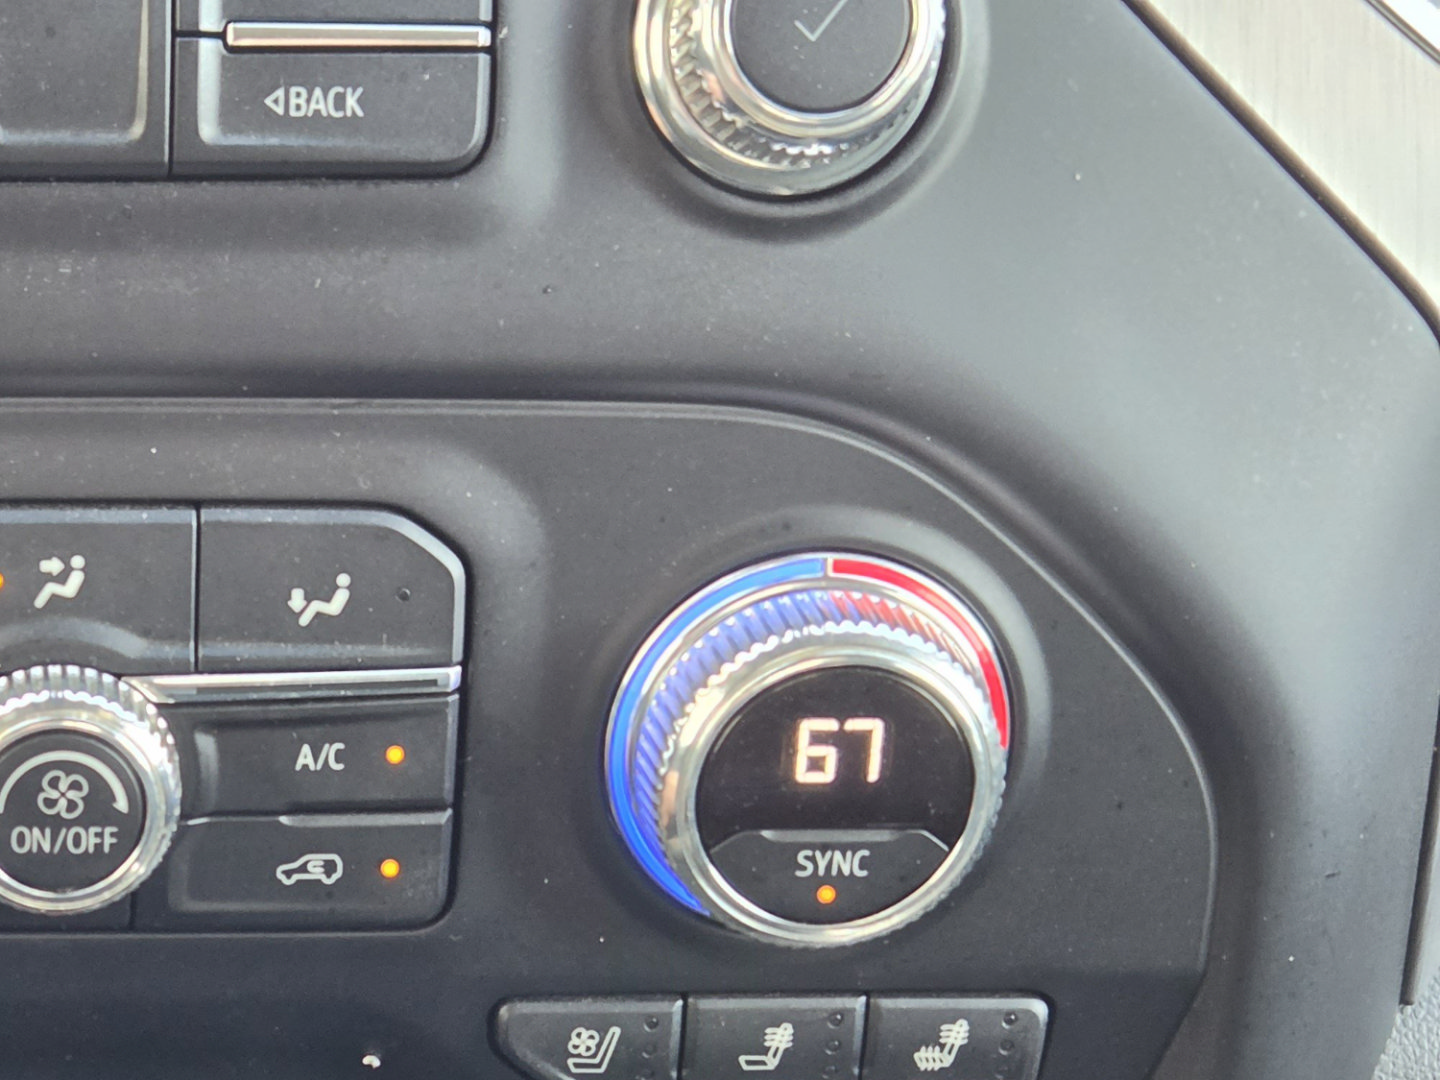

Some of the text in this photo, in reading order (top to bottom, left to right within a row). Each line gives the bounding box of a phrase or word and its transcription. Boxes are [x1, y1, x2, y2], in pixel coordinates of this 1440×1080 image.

[289, 85, 364, 118] BACK
[295, 742, 346, 771] A/C
[794, 716, 885, 785] 67
[10, 825, 119, 855] ON/OFF
[794, 849, 871, 877] SYNC
